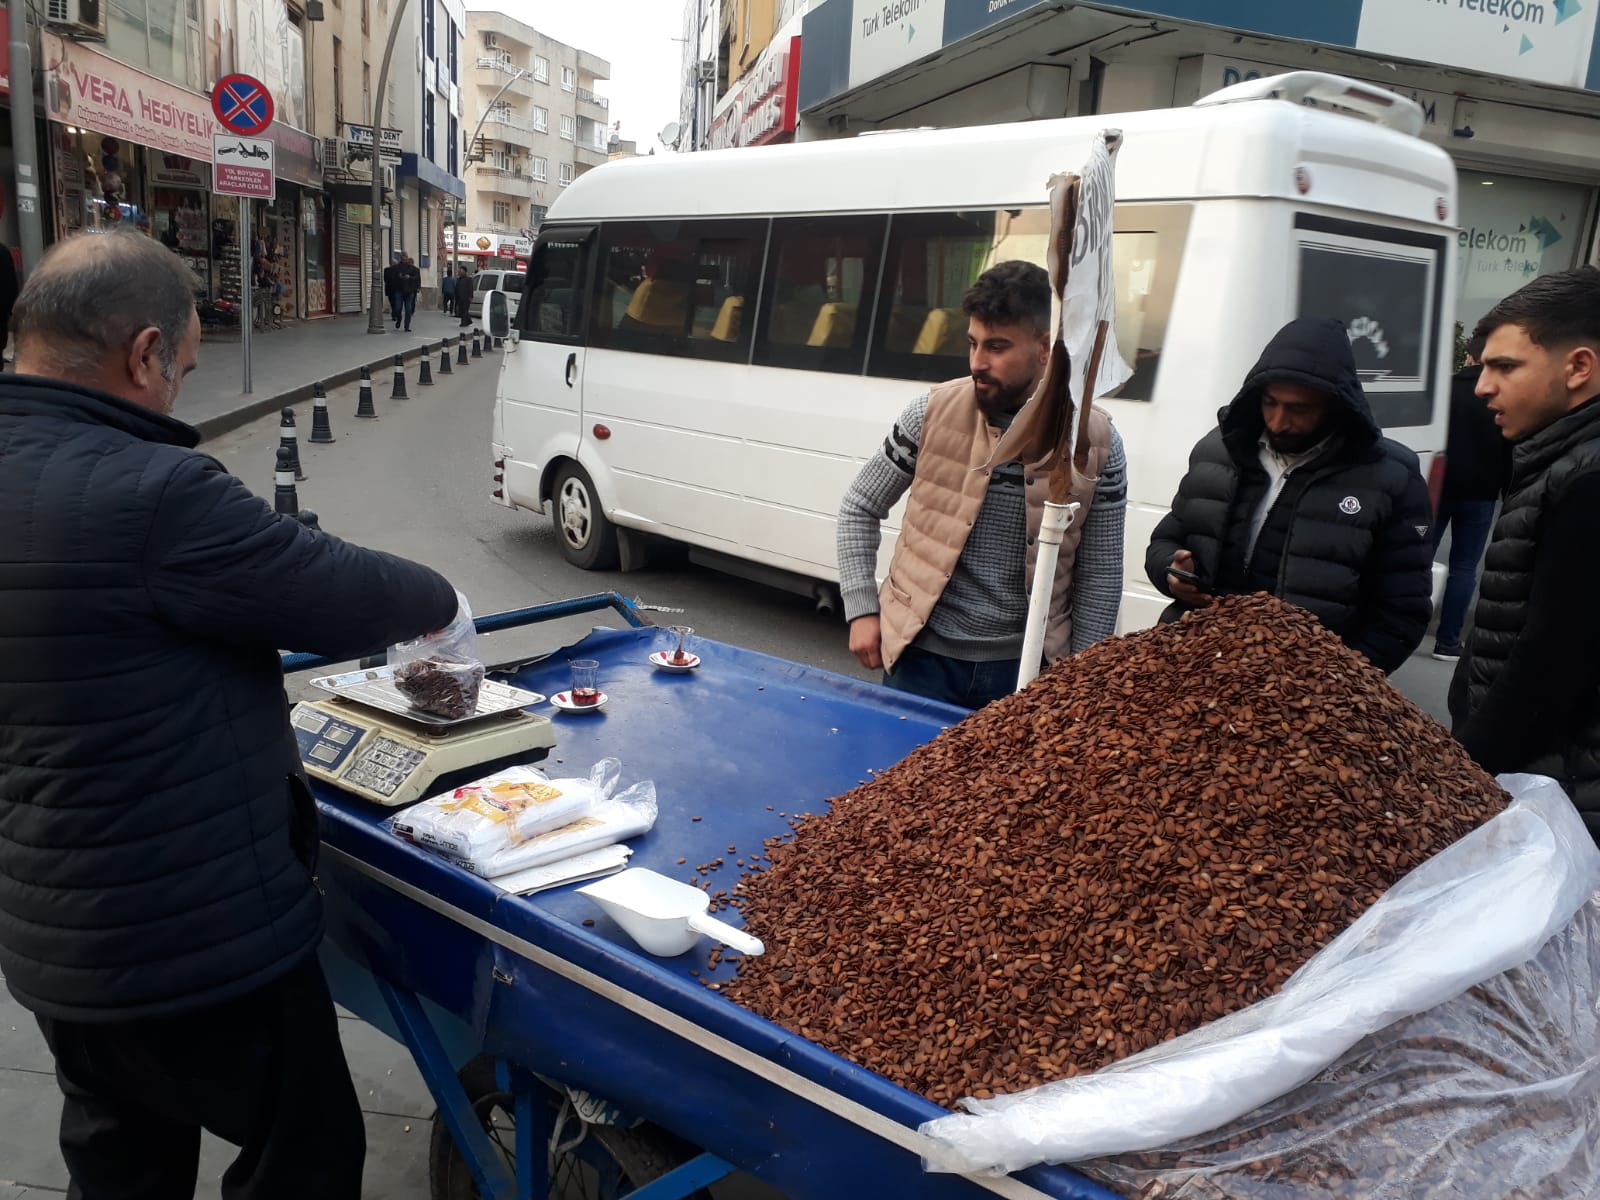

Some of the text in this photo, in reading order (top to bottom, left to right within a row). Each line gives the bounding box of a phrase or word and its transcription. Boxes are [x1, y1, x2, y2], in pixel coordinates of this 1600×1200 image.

[862, 0, 920, 39] Türk Telekom
[69, 61, 134, 118] VERA
[138, 89, 214, 139] HEDİYELİK
[384, 131, 401, 141] DENT
[224, 167, 265, 178] YOL BOYUNCA
[219, 180, 247, 188] ARAÇLAR
[1457, 226, 1527, 253] elekom
